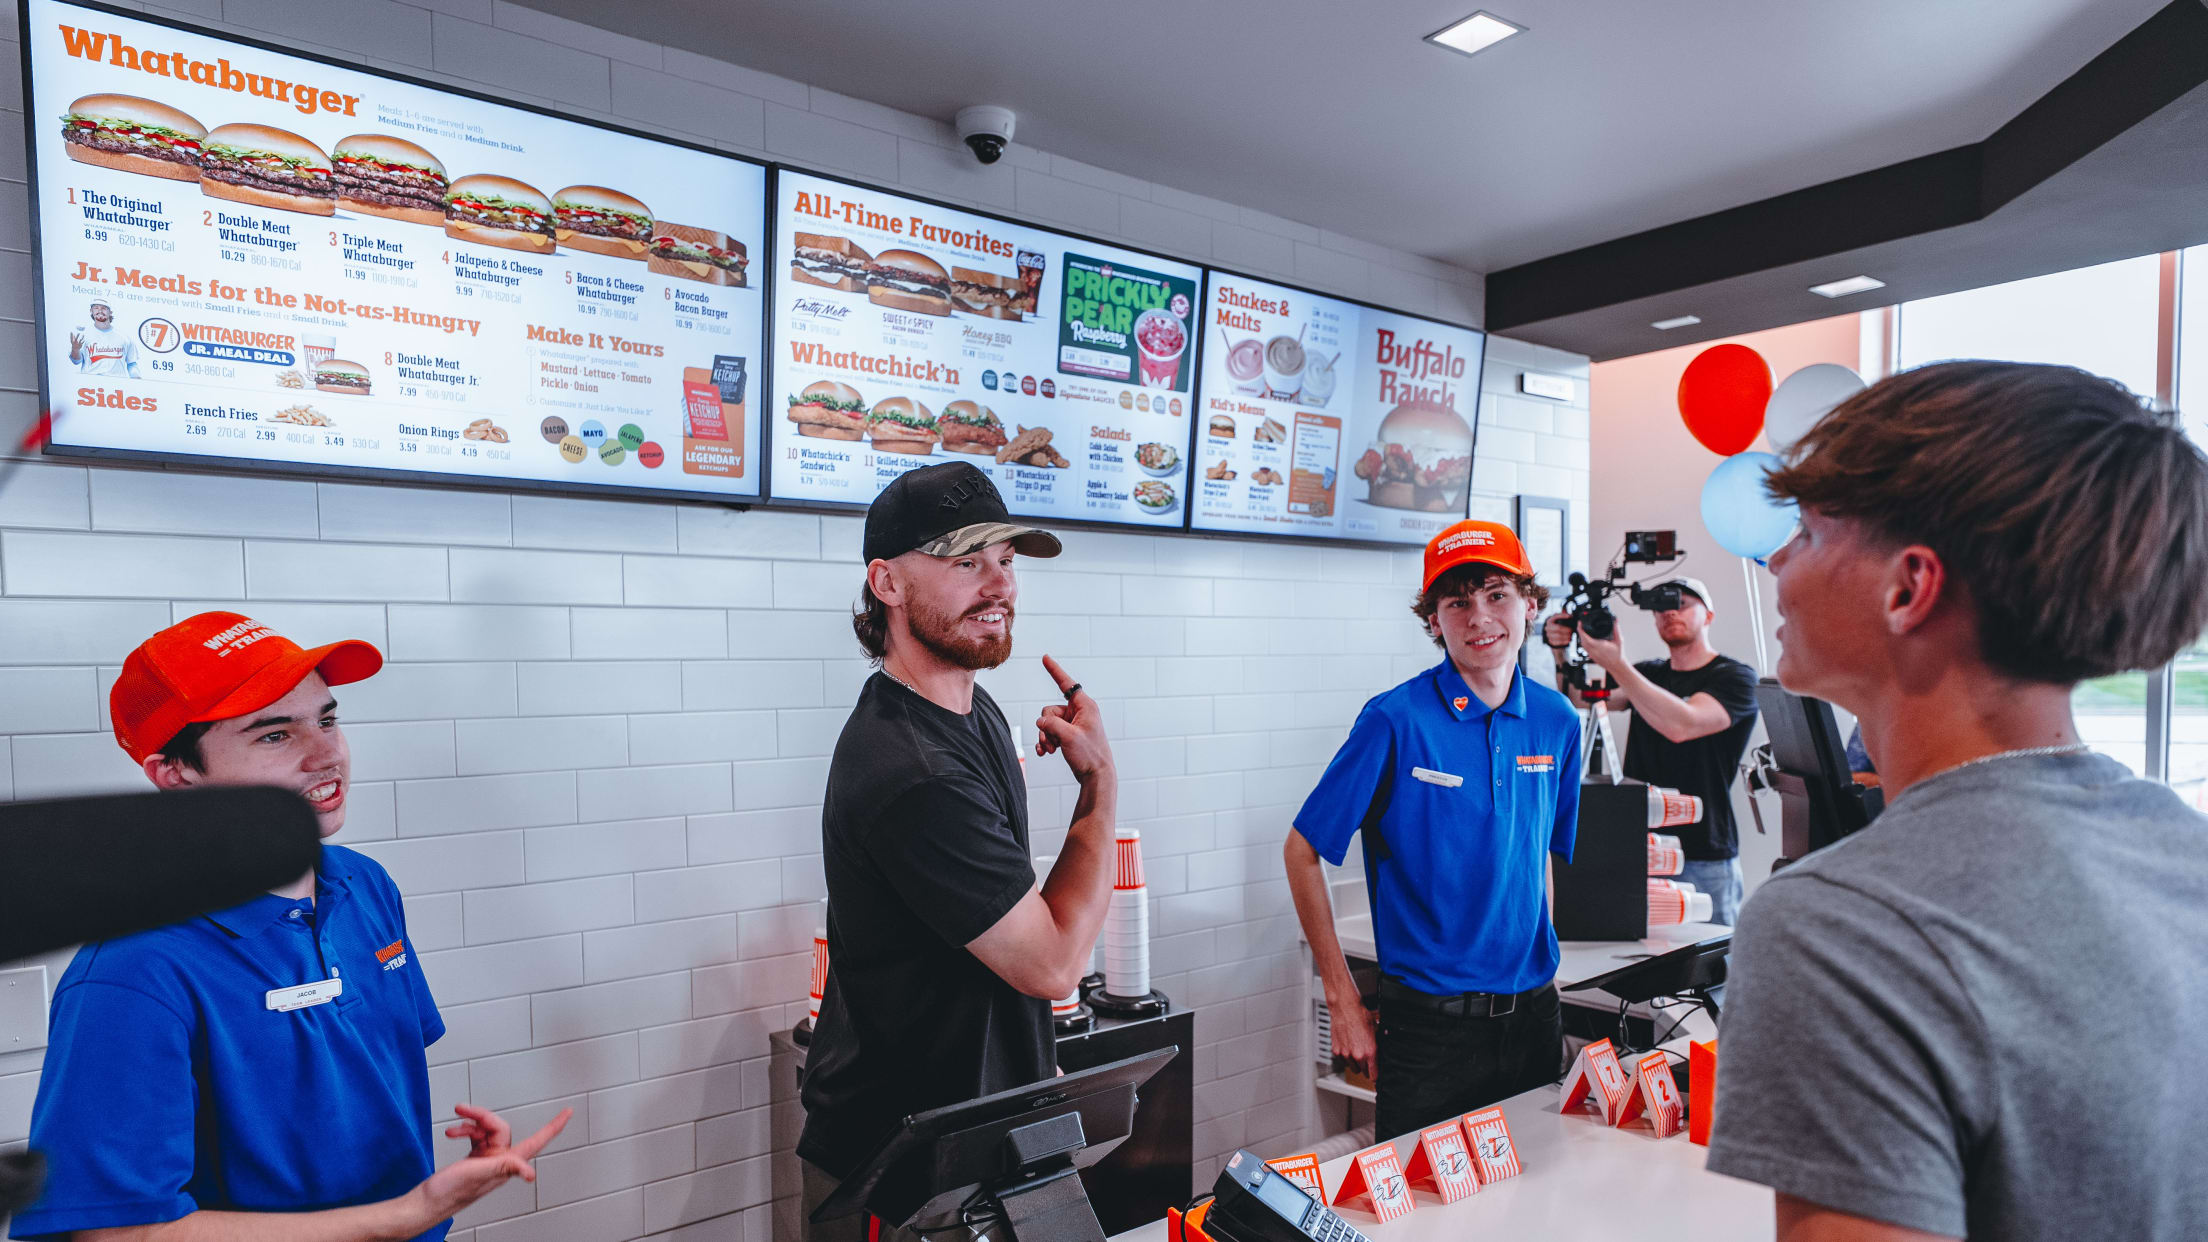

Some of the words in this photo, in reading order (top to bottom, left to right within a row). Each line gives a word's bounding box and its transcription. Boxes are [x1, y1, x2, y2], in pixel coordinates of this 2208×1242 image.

[59, 24, 360, 117] Whataburger
[378, 104, 403, 116] Meals
[422, 114, 435, 123] are
[437, 117, 464, 130] served
[466, 124, 484, 134] with
[378, 116, 415, 130] Medium
[416, 124, 438, 134] Fries
[440, 128, 455, 138] and
[465, 134, 499, 149] Medium
[67, 188, 76, 204] 1
[82, 190, 106, 205] The
[110, 195, 162, 214] Original
[83, 206, 170, 231] Whataburger
[203, 210, 213, 226] 2
[218, 213, 258, 230] Double
[262, 220, 290, 235] Meat
[794, 191, 903, 234] All-Time
[909, 216, 1014, 258] Favorites
[85, 229, 107, 242] 8.99
[119, 234, 159, 250] 620-1430
[161, 240, 175, 252] Cal
[219, 228, 297, 252] Whataburger
[329, 232, 337, 246] 3
[343, 234, 374, 250] Triple
[377, 239, 403, 254] Meat
[221, 250, 245, 262] 10.29
[289, 261, 302, 272] Cal
[343, 248, 415, 270] Whataburger
[442, 250, 450, 264] 4
[455, 252, 499, 269] Jalapeño
[502, 260, 508, 270] &
[510, 262, 543, 276] Cheese
[344, 269, 366, 280] 11.99
[407, 278, 418, 289] Cal
[455, 266, 520, 287] Whataburger
[566, 271, 572, 284] 5
[577, 272, 603, 286] Bacon
[606, 276, 612, 287] &
[614, 278, 644, 293] Cheese
[456, 286, 472, 296] 9.99
[577, 286, 636, 305] Whataburger
[664, 287, 671, 300] 6
[675, 289, 710, 303] Avocado
[1067, 268, 1171, 310] PRICKLY
[72, 261, 108, 284] Jr.
[115, 266, 202, 296] Meals
[209, 279, 248, 302] for
[254, 286, 297, 310] the
[304, 294, 480, 337] Not-as-Hungry
[72, 284, 102, 297] Meals
[126, 292, 143, 301] are
[145, 294, 179, 306] served
[181, 298, 203, 309] with
[204, 302, 235, 314] Small
[237, 306, 262, 317] Fries
[291, 314, 319, 324] Small
[792, 298, 822, 318] Patty
[821, 305, 852, 318] Melt
[1218, 286, 1277, 314] Shakes
[1280, 300, 1290, 318] &
[578, 304, 596, 315] 10.99
[675, 302, 699, 314] Bacon
[701, 308, 728, 320] Burger
[1066, 296, 1134, 334] PEAR
[675, 319, 693, 328] 10.99
[882, 312, 907, 326] SWEET
[1216, 308, 1262, 332] Malts
[181, 322, 295, 351] WITTABURGER
[527, 324, 584, 346] Make
[588, 333, 604, 350] It
[609, 336, 664, 358] Yours
[962, 324, 994, 346] Honey
[995, 332, 1012, 345] BBQ
[1071, 320, 1128, 349] Raspberry
[189, 343, 211, 356] JR.
[213, 345, 252, 360] MEAL
[254, 351, 290, 364] DEAL
[385, 352, 392, 366] 8
[398, 353, 432, 367] Double
[435, 358, 460, 370] Meat
[1377, 328, 1466, 380] Buffalo
[152, 360, 174, 371] 6.99
[185, 363, 220, 377] 340-860
[222, 367, 236, 378] Cal
[790, 341, 960, 385] Whatachick'n
[398, 367, 465, 386] Whataburger
[468, 376, 480, 386] Jr.
[541, 362, 578, 376] Mustard
[584, 367, 616, 380] Lettuce
[621, 372, 652, 384] Tomato
[713, 368, 740, 383] KETCHUP
[400, 386, 416, 397] 7.99
[455, 392, 466, 402] Cal
[541, 377, 569, 390] Pickle
[574, 380, 599, 394] Onion
[1380, 370, 1455, 412] Ranch
[77, 388, 158, 412] Sides
[1210, 398, 1235, 412] Kid's
[1238, 403, 1266, 416] Menu
[185, 404, 226, 420] French
[229, 408, 258, 420] Fries
[690, 402, 720, 420] KETCHUP
[186, 424, 207, 436] 2.69
[217, 426, 232, 438] 270
[233, 428, 246, 439] Cal
[256, 430, 276, 441] 2.99
[302, 434, 315, 444] Cal
[324, 436, 344, 446] 3.49
[352, 438, 366, 449] 530
[368, 439, 380, 450] Cal
[398, 424, 428, 436] Onion
[431, 426, 460, 440] Rings
[544, 424, 566, 435] BACON
[583, 430, 604, 438] MAYO
[1090, 426, 1132, 441] Salads
[400, 442, 416, 452] 3.59
[462, 448, 478, 458] 4.19
[562, 442, 583, 456] CHEESE
[600, 446, 624, 460] AVOCADO
[786, 447, 798, 460] 10
[801, 448, 850, 462] Whatachick'n
[686, 452, 742, 466] LEGENDARY
[800, 460, 836, 472] Sandwich
[865, 455, 874, 467] 11
[876, 456, 899, 466] Grilled
[1445, 538, 1486, 552] TRAINER
[297, 990, 317, 998] JACOB
[1658, 1080, 1670, 1102] 2
[1468, 1110, 1501, 1126] WITTABURGER
[1426, 1124, 1458, 1141] WITTABURGER
[1360, 1146, 1394, 1166] WITTABURGER
